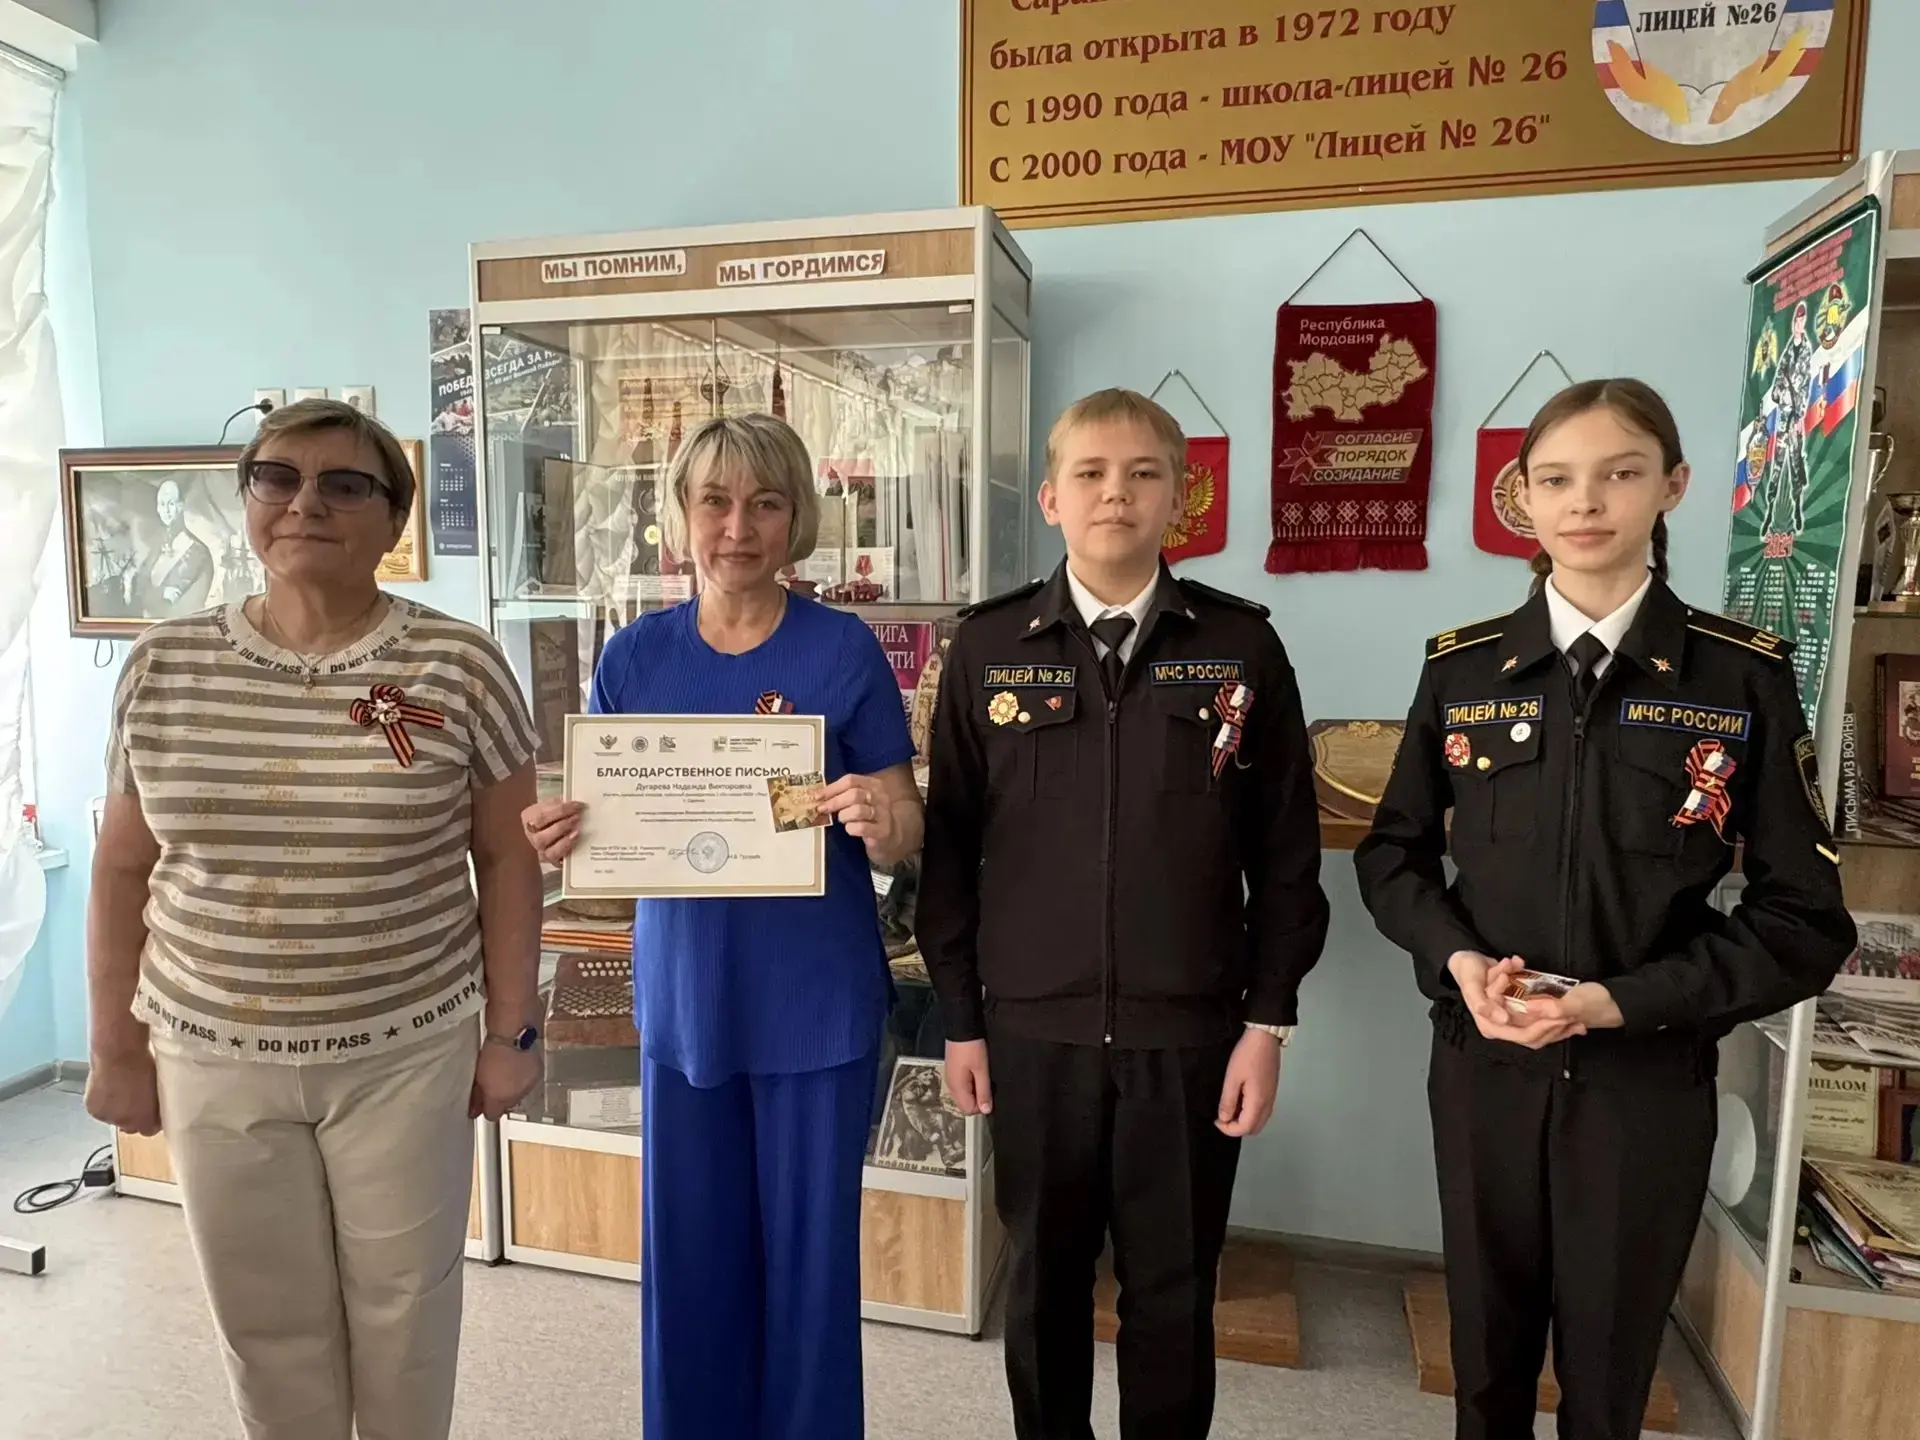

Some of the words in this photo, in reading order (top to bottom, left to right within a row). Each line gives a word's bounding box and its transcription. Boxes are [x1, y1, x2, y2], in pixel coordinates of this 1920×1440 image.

[1636, 2, 1716, 33] ЛИЦЕЙ
[1726, 2, 1777, 27] №26
[990, 38, 1073, 71] была
[1082, 26, 1228, 66] открыта
[1238, 23, 1259, 46] в
[1274, 8, 1361, 43] 1972
[1372, 3, 1457, 37] году
[989, 100, 1010, 127] С
[1025, 92, 1103, 124] 1990
[1113, 88, 1189, 122] года
[1220, 60, 1455, 109] школа-лицей
[1466, 52, 1508, 86] №
[1520, 49, 1569, 83] 26
[989, 156, 1010, 184] С
[1021, 149, 1102, 181] 2000
[1112, 145, 1187, 178] года
[1219, 132, 1296, 167] МОУ
[1305, 123, 1427, 163] "Лицей
[1439, 117, 1477, 150] №
[1492, 113, 1551, 146] 26"
[544, 261, 578, 281] МЫ
[584, 254, 683, 277] ПОМНИМ,
[719, 264, 756, 284] МЫ
[761, 252, 882, 281] ГОРДИМСЯ
[1300, 317, 1386, 333] Республика
[1299, 333, 1374, 348] Мордовия
[527, 351, 542, 364] ЗА
[1335, 432, 1414, 445] СОГЛАСИЕ
[1335, 450, 1408, 463] ПОРЯДОК
[1313, 468, 1402, 481] СОЗИДАНИЕ
[871, 624, 909, 643] НИГА
[239, 647, 255, 661] DO
[254, 656, 273, 669] NOT
[274, 663, 301, 674] PASS
[330, 664, 346, 674] DO
[349, 655, 369, 670] NOT
[371, 635, 399, 660] PASS
[886, 650, 915, 669] ЯТИ
[987, 666, 1033, 684] ЛИЦЕЙ
[1054, 671, 1071, 684] 26
[1155, 667, 1184, 681] МЧС
[1188, 664, 1240, 680] РОССИИ
[1446, 699, 1495, 724] ЛИЦЕЙ
[1520, 702, 1538, 717] 26
[1627, 703, 1665, 723] МЧС
[1671, 708, 1743, 734] РОССИИ
[597, 767, 732, 779] БЛАГОДАРСТВЕННОЕ
[736, 767, 790, 777] ПИСЬМО
[1845, 780, 1858, 832] ПИСЬМА
[147, 996, 161, 1011] DO
[181, 1019, 218, 1042] PASS
[412, 1010, 435, 1029] DO
[436, 993, 463, 1019] NOT
[258, 1038, 282, 1052] DO
[288, 1038, 320, 1053] NOT
[326, 1032, 371, 1051] PASS
[1808, 1078, 1867, 1092] ИПЛОМ
